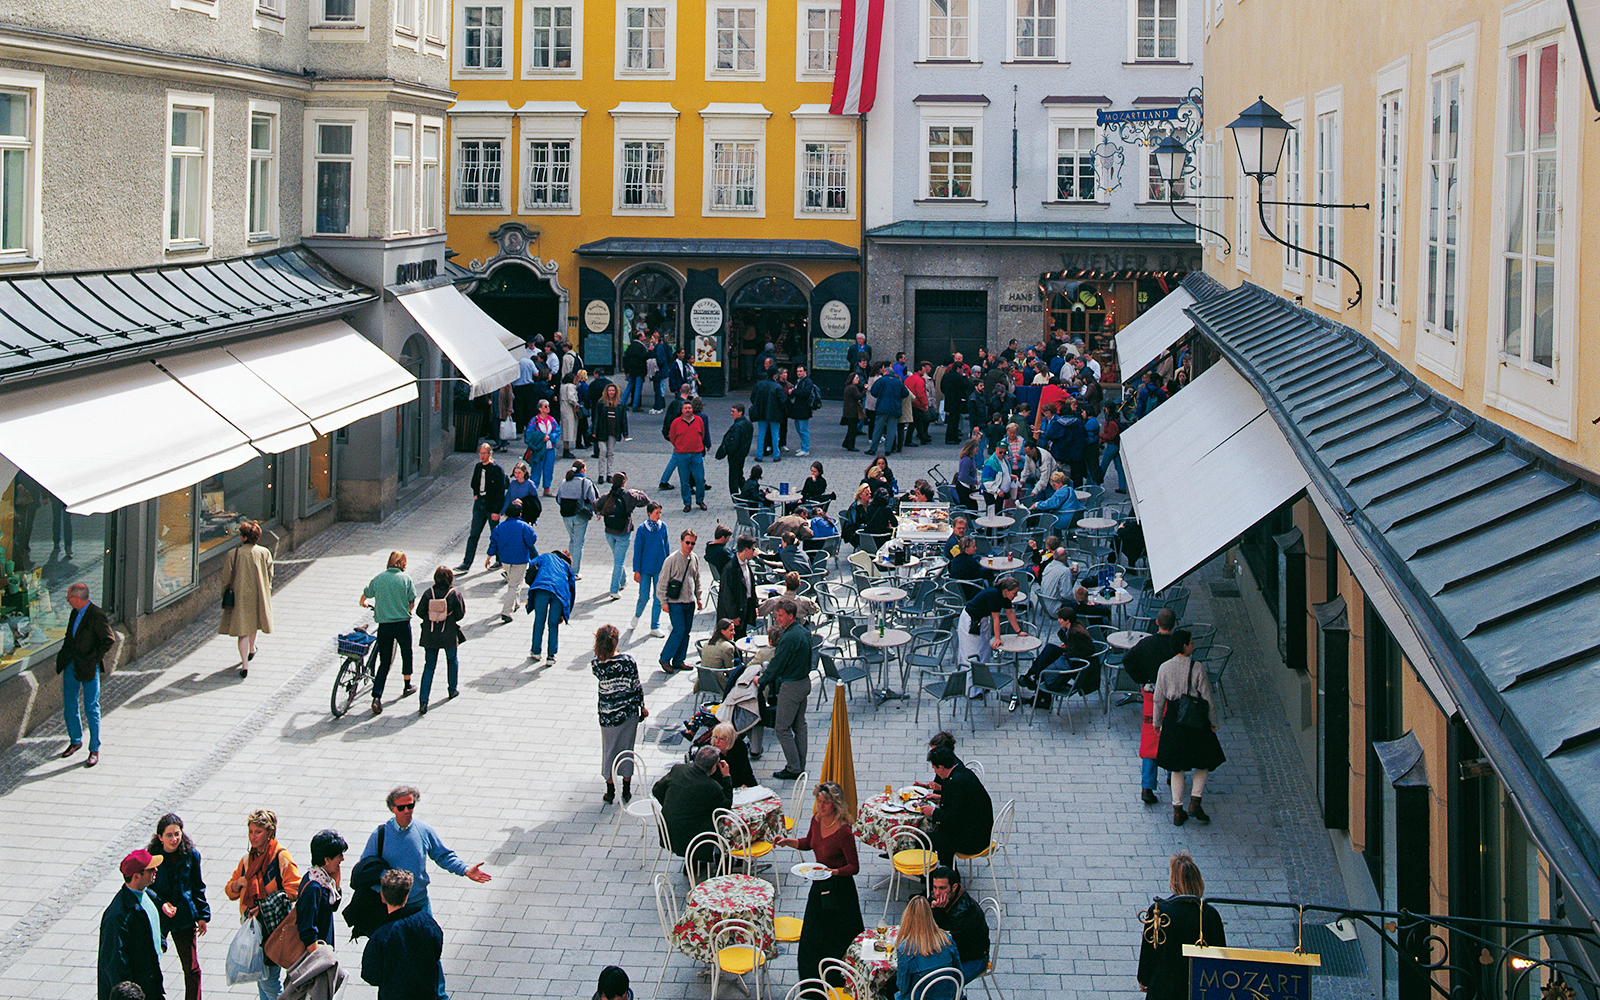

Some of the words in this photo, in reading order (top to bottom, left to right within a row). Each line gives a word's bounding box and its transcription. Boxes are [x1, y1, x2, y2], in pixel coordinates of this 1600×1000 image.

[1059, 252, 1148, 271] WIENER
[881, 294, 890, 305] 11
[1009, 292, 1034, 301] HANS
[999, 304, 1043, 313] FEICHTNER
[1199, 969, 1303, 995] MOZART
